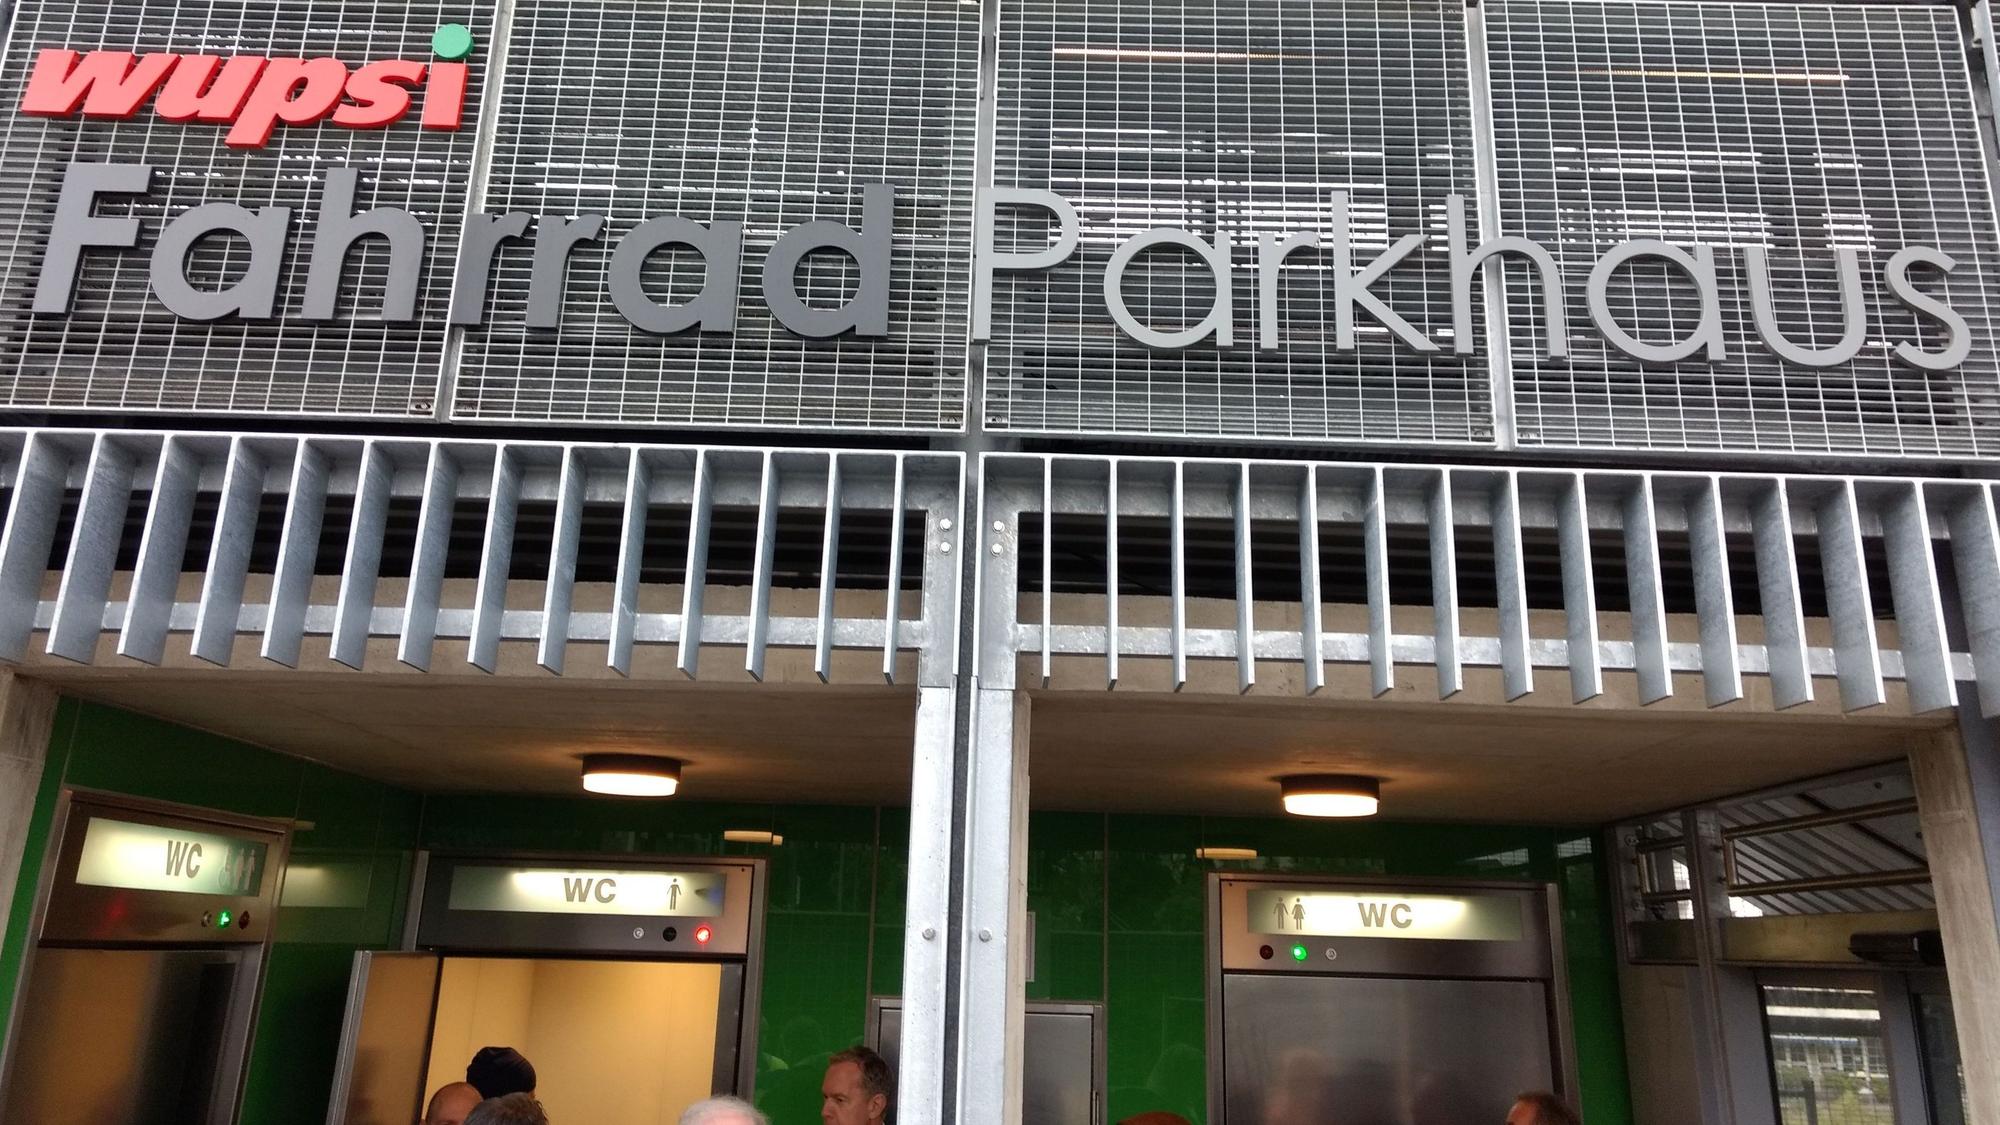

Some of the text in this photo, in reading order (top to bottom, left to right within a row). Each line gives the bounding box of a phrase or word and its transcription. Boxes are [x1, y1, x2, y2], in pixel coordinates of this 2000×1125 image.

[21, 23, 474, 149] wupsi
[31, 162, 1972, 372] Fahrrad Parkhaus
[164, 839, 203, 879] WC
[563, 877, 617, 904] WC
[1357, 902, 1413, 929] WC
